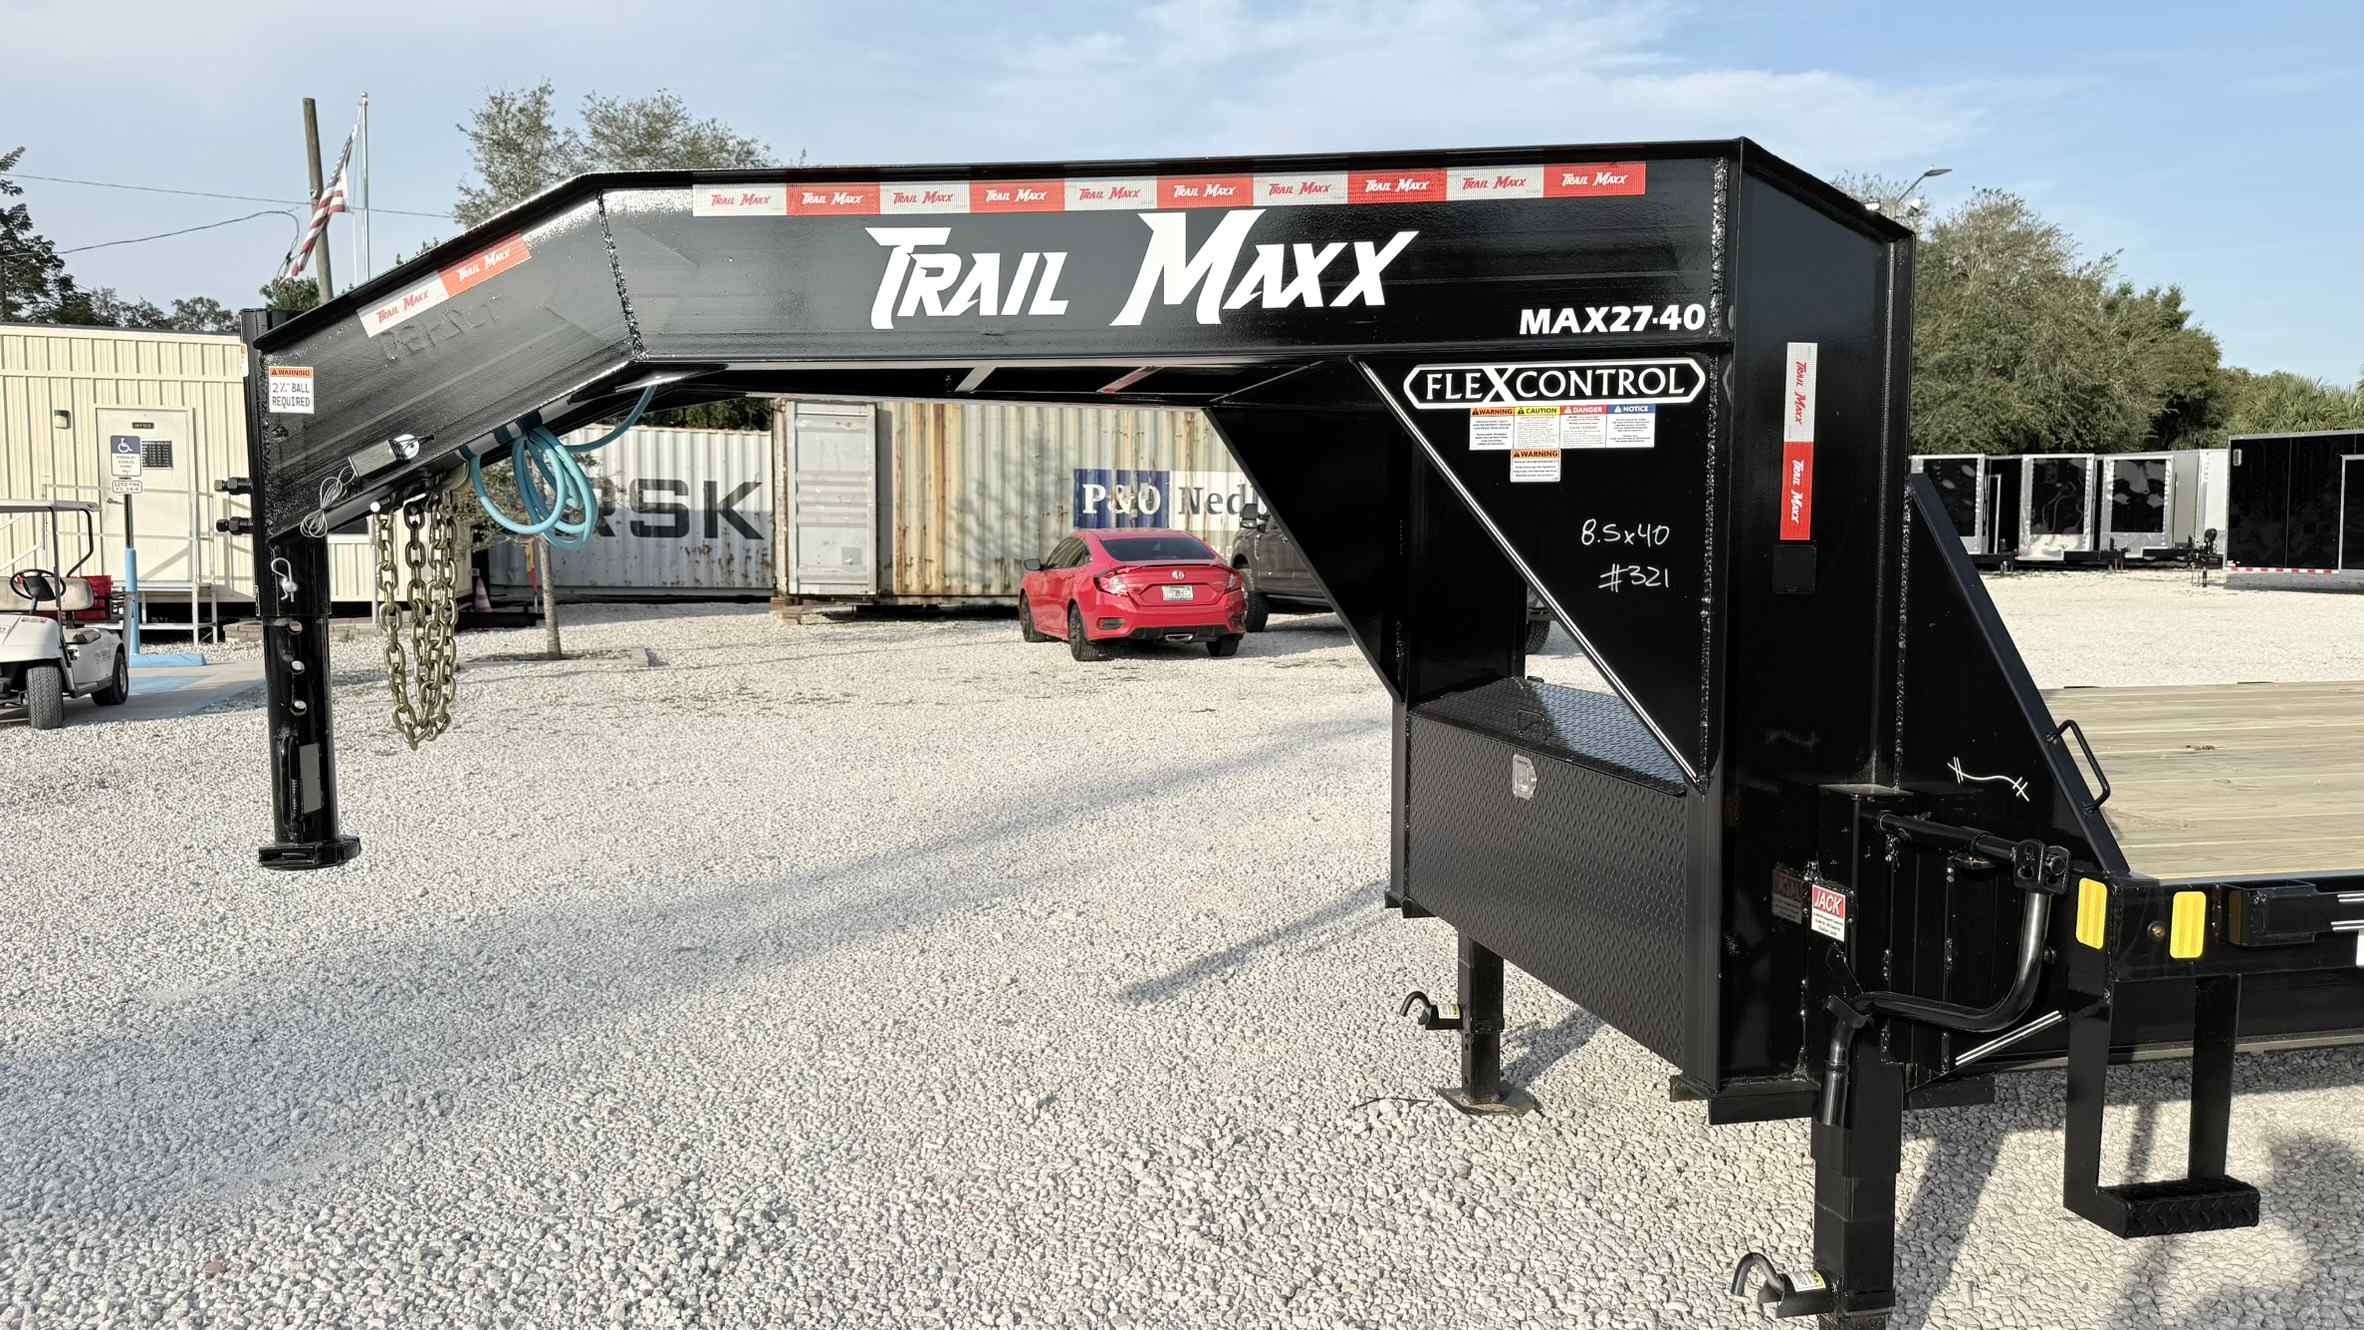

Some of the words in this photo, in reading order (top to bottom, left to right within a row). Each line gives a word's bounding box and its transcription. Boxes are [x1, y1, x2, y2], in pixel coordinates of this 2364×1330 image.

[865, 227, 1068, 329] TRAIL
[1109, 208, 1419, 327] MAXX
[292, 382, 310, 394] BALL
[272, 396, 311, 408] REQUIRED
[1479, 408, 1513, 416] WARNING
[1525, 407, 1558, 415] CAUTION
[1573, 406, 1603, 414] DANGER
[1622, 405, 1648, 413] NOTICE
[1520, 450, 1559, 458] WARNING
[1082, 484, 1161, 517] P&O
[1581, 518, 1670, 548] 8.5x40
[1599, 564, 1668, 592] #321
[1814, 890, 1843, 915] JACK
